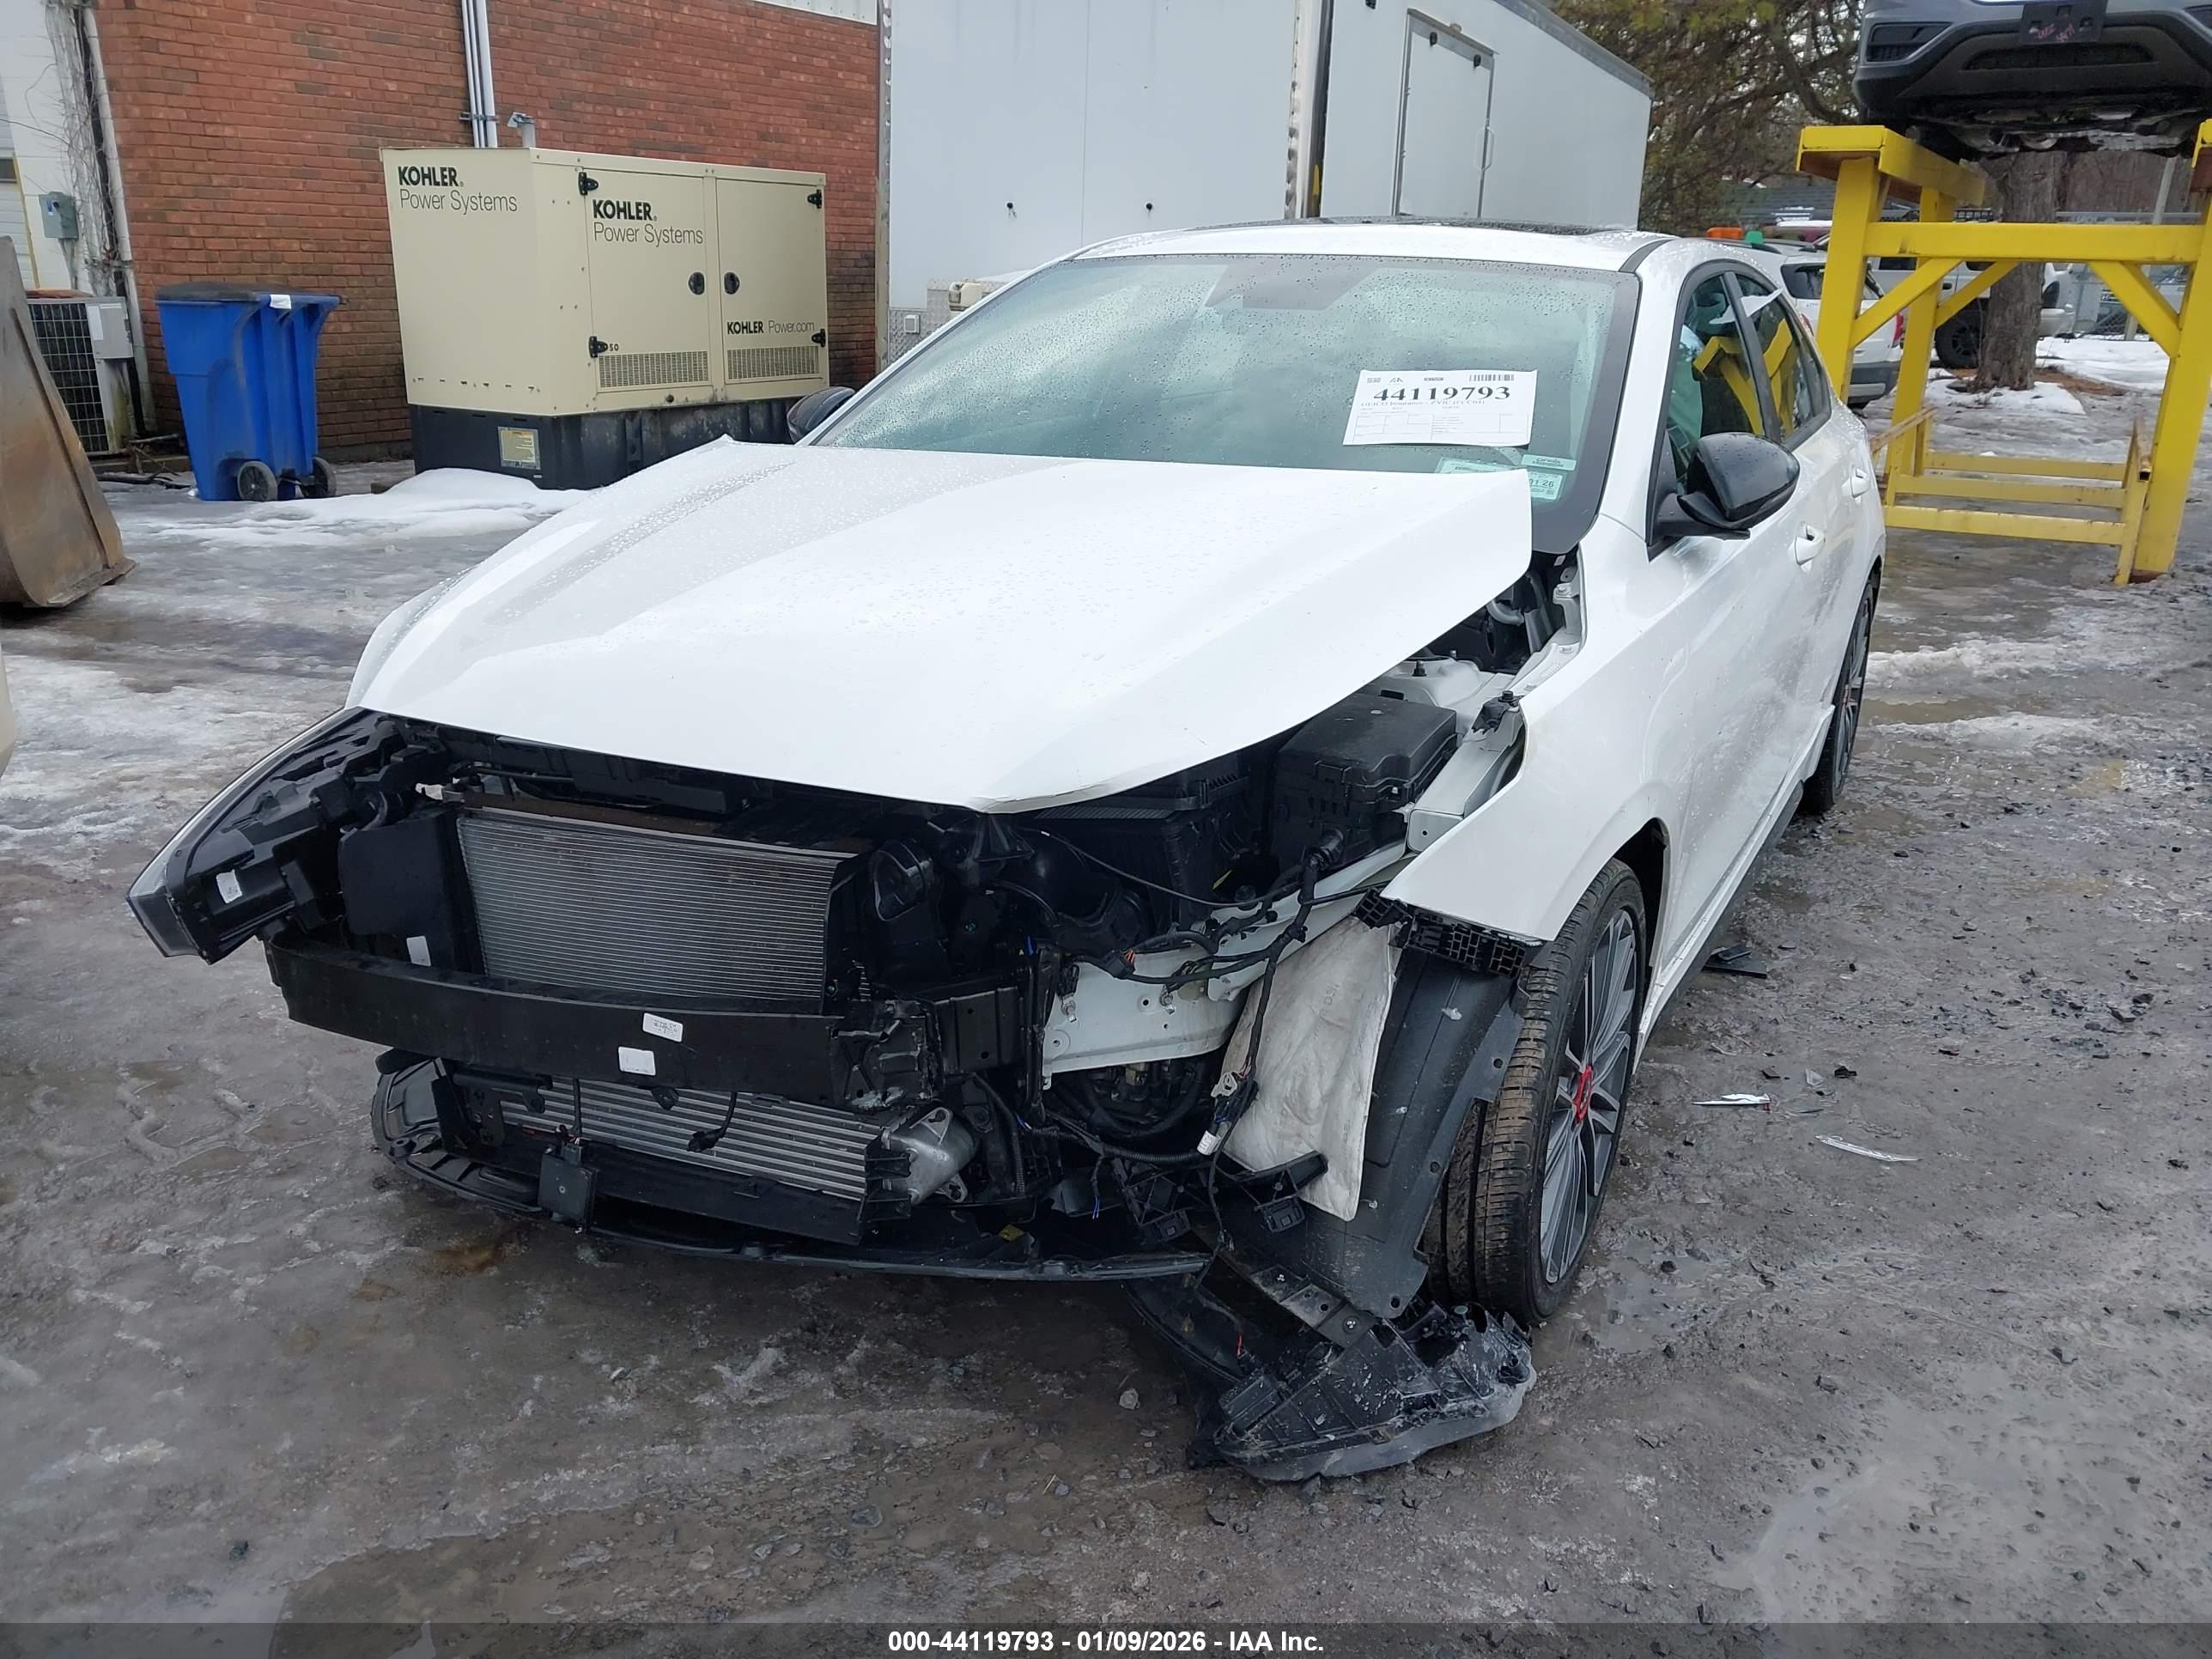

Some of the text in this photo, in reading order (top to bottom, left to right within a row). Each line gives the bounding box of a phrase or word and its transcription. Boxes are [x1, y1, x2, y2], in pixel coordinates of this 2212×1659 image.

[398, 166, 459, 186] KOHLER
[399, 188, 518, 215] Power Systems
[592, 198, 653, 221] KOHLER
[593, 222, 704, 247] Power Systems
[726, 319, 815, 334] KOHLER Power.com
[1374, 386, 1511, 401] 44119793
